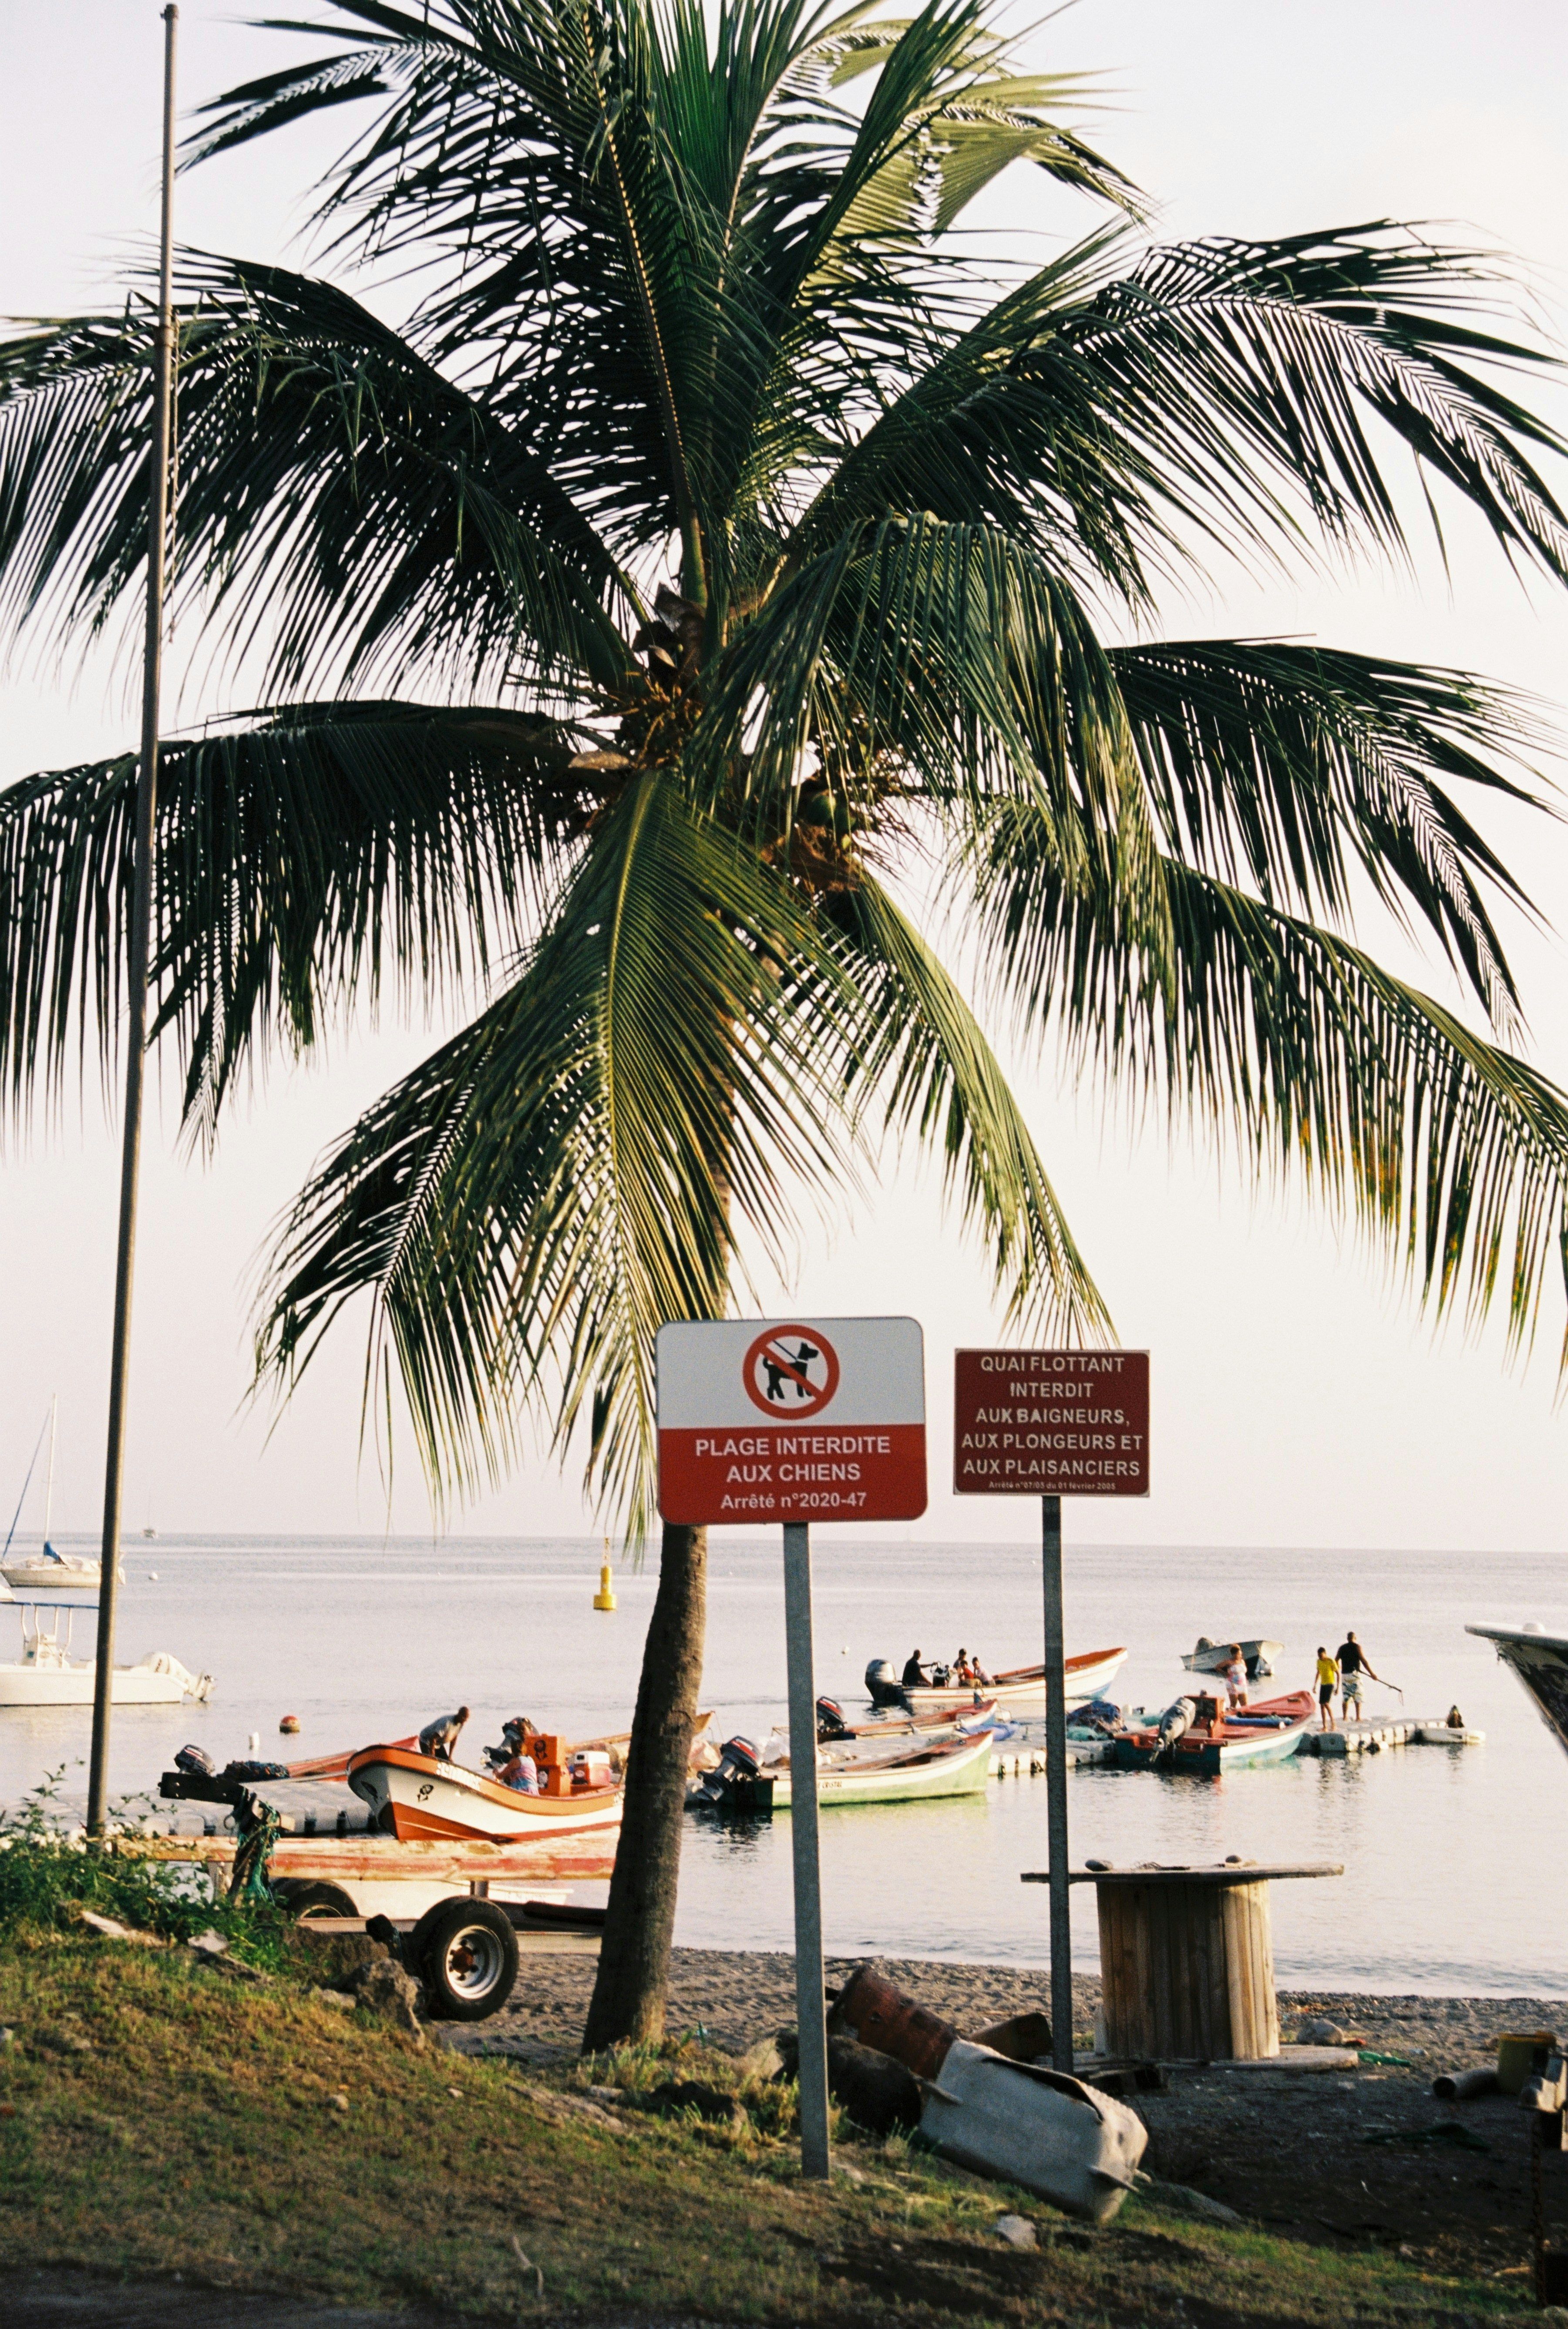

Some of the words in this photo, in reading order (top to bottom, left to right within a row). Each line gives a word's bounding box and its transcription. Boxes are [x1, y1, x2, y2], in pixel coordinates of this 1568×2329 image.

[981, 1356, 1025, 1372] QUAI
[1030, 1356, 1124, 1372] FLOTTANT
[1010, 1382, 1094, 1397] INTERDIT
[976, 1408, 1013, 1424] AUX
[1016, 1408, 1129, 1426] BAIGNEURS,
[696, 1438, 769, 1456] PLAGE
[777, 1436, 890, 1454] INTERDITE
[962, 1434, 998, 1448] AUX
[1003, 1434, 1116, 1450] PLONGEURS
[1121, 1435, 1143, 1450] ET
[727, 1465, 772, 1482] AUX
[779, 1463, 861, 1481] CHIENS
[963, 1459, 1000, 1474] AUX
[1006, 1459, 1140, 1476] PLAISANCIERS
[721, 1494, 775, 1509] Arrêté
[781, 1492, 866, 1508] n°2020-47
